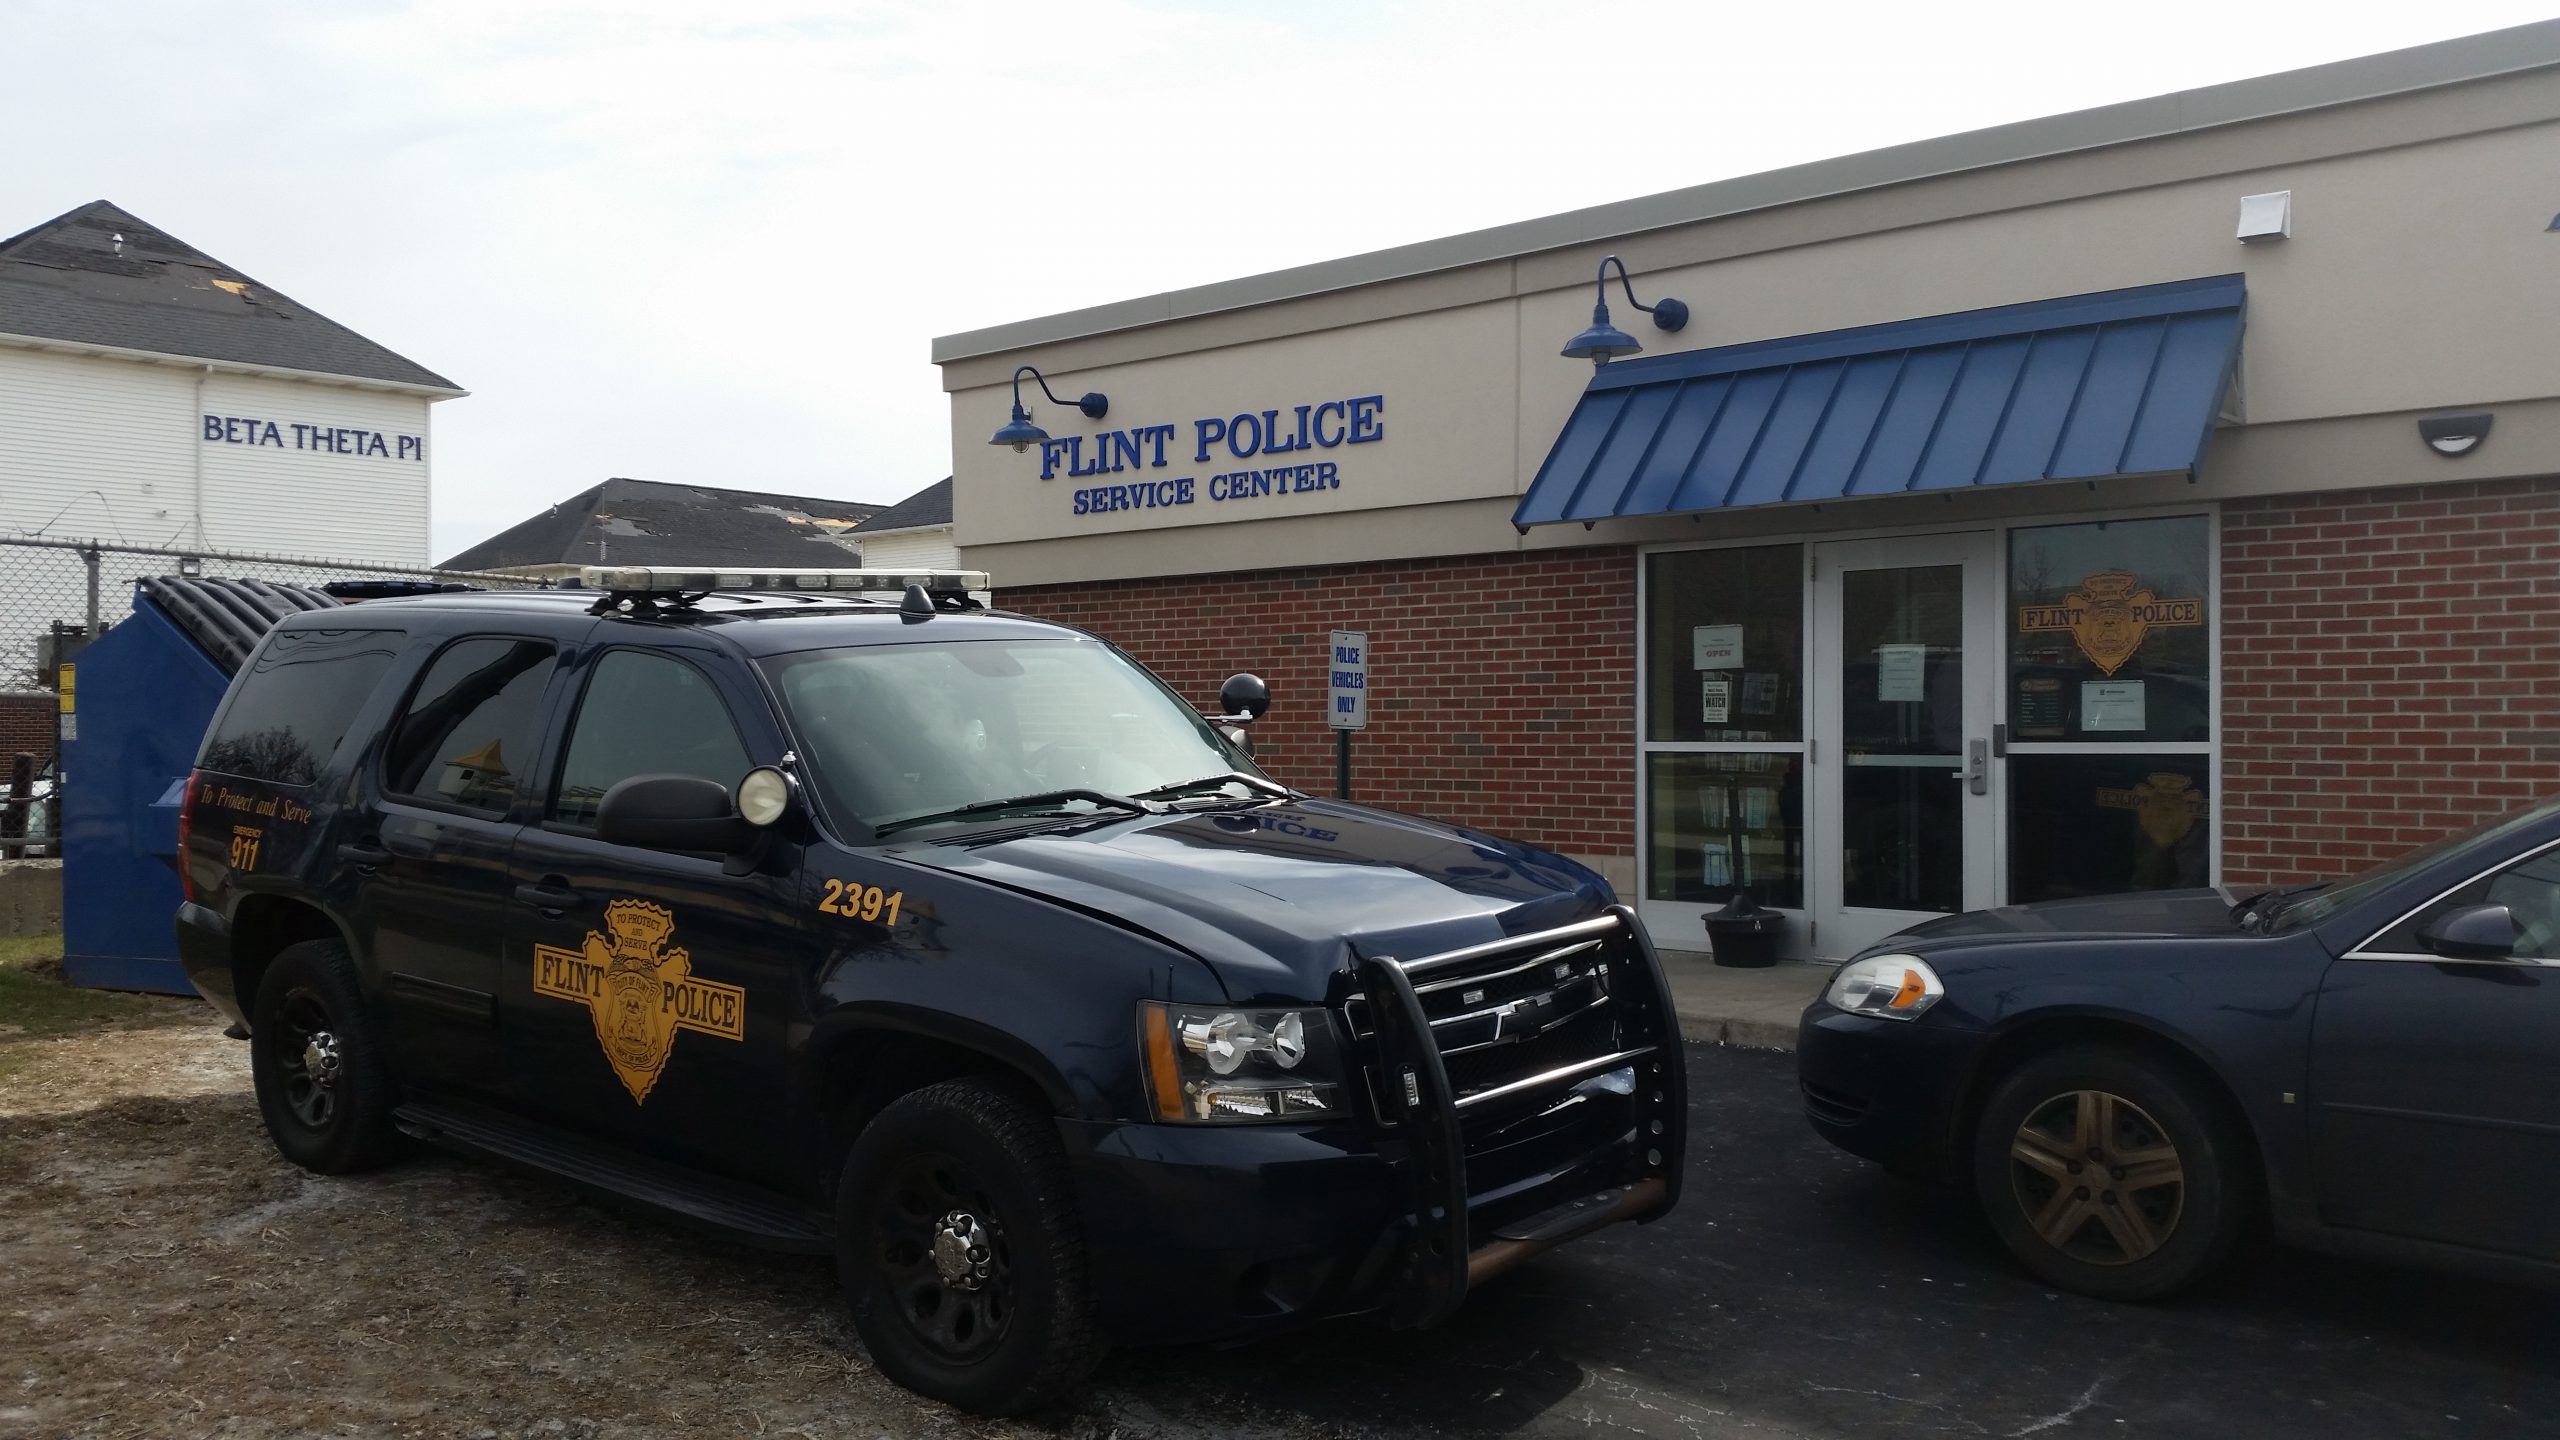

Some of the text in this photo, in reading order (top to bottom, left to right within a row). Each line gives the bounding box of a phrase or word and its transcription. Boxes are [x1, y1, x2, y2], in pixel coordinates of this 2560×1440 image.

[203, 415, 422, 461] BETA THETA PI
[1041, 395, 1383, 480] FLINT POLICE
[1074, 463, 1339, 514] SERVICE CENTER
[2026, 608, 2084, 627] FLINT
[2132, 603, 2196, 623] POLICE
[1336, 647, 1359, 664] POLICE
[1332, 671, 1363, 689] VEHICLES
[1337, 696, 1355, 713] ONLY
[1705, 697, 1726, 708] WATCH
[200, 783, 312, 825] To Protect and Serve
[231, 836, 260, 872] 911
[820, 879, 903, 926] 2391
[616, 913, 661, 931] TO PROTECT
[631, 928, 643, 936] AND
[624, 937, 648, 951] SERVE
[541, 954, 605, 998] FLINT
[661, 981, 736, 1028] POLICE
